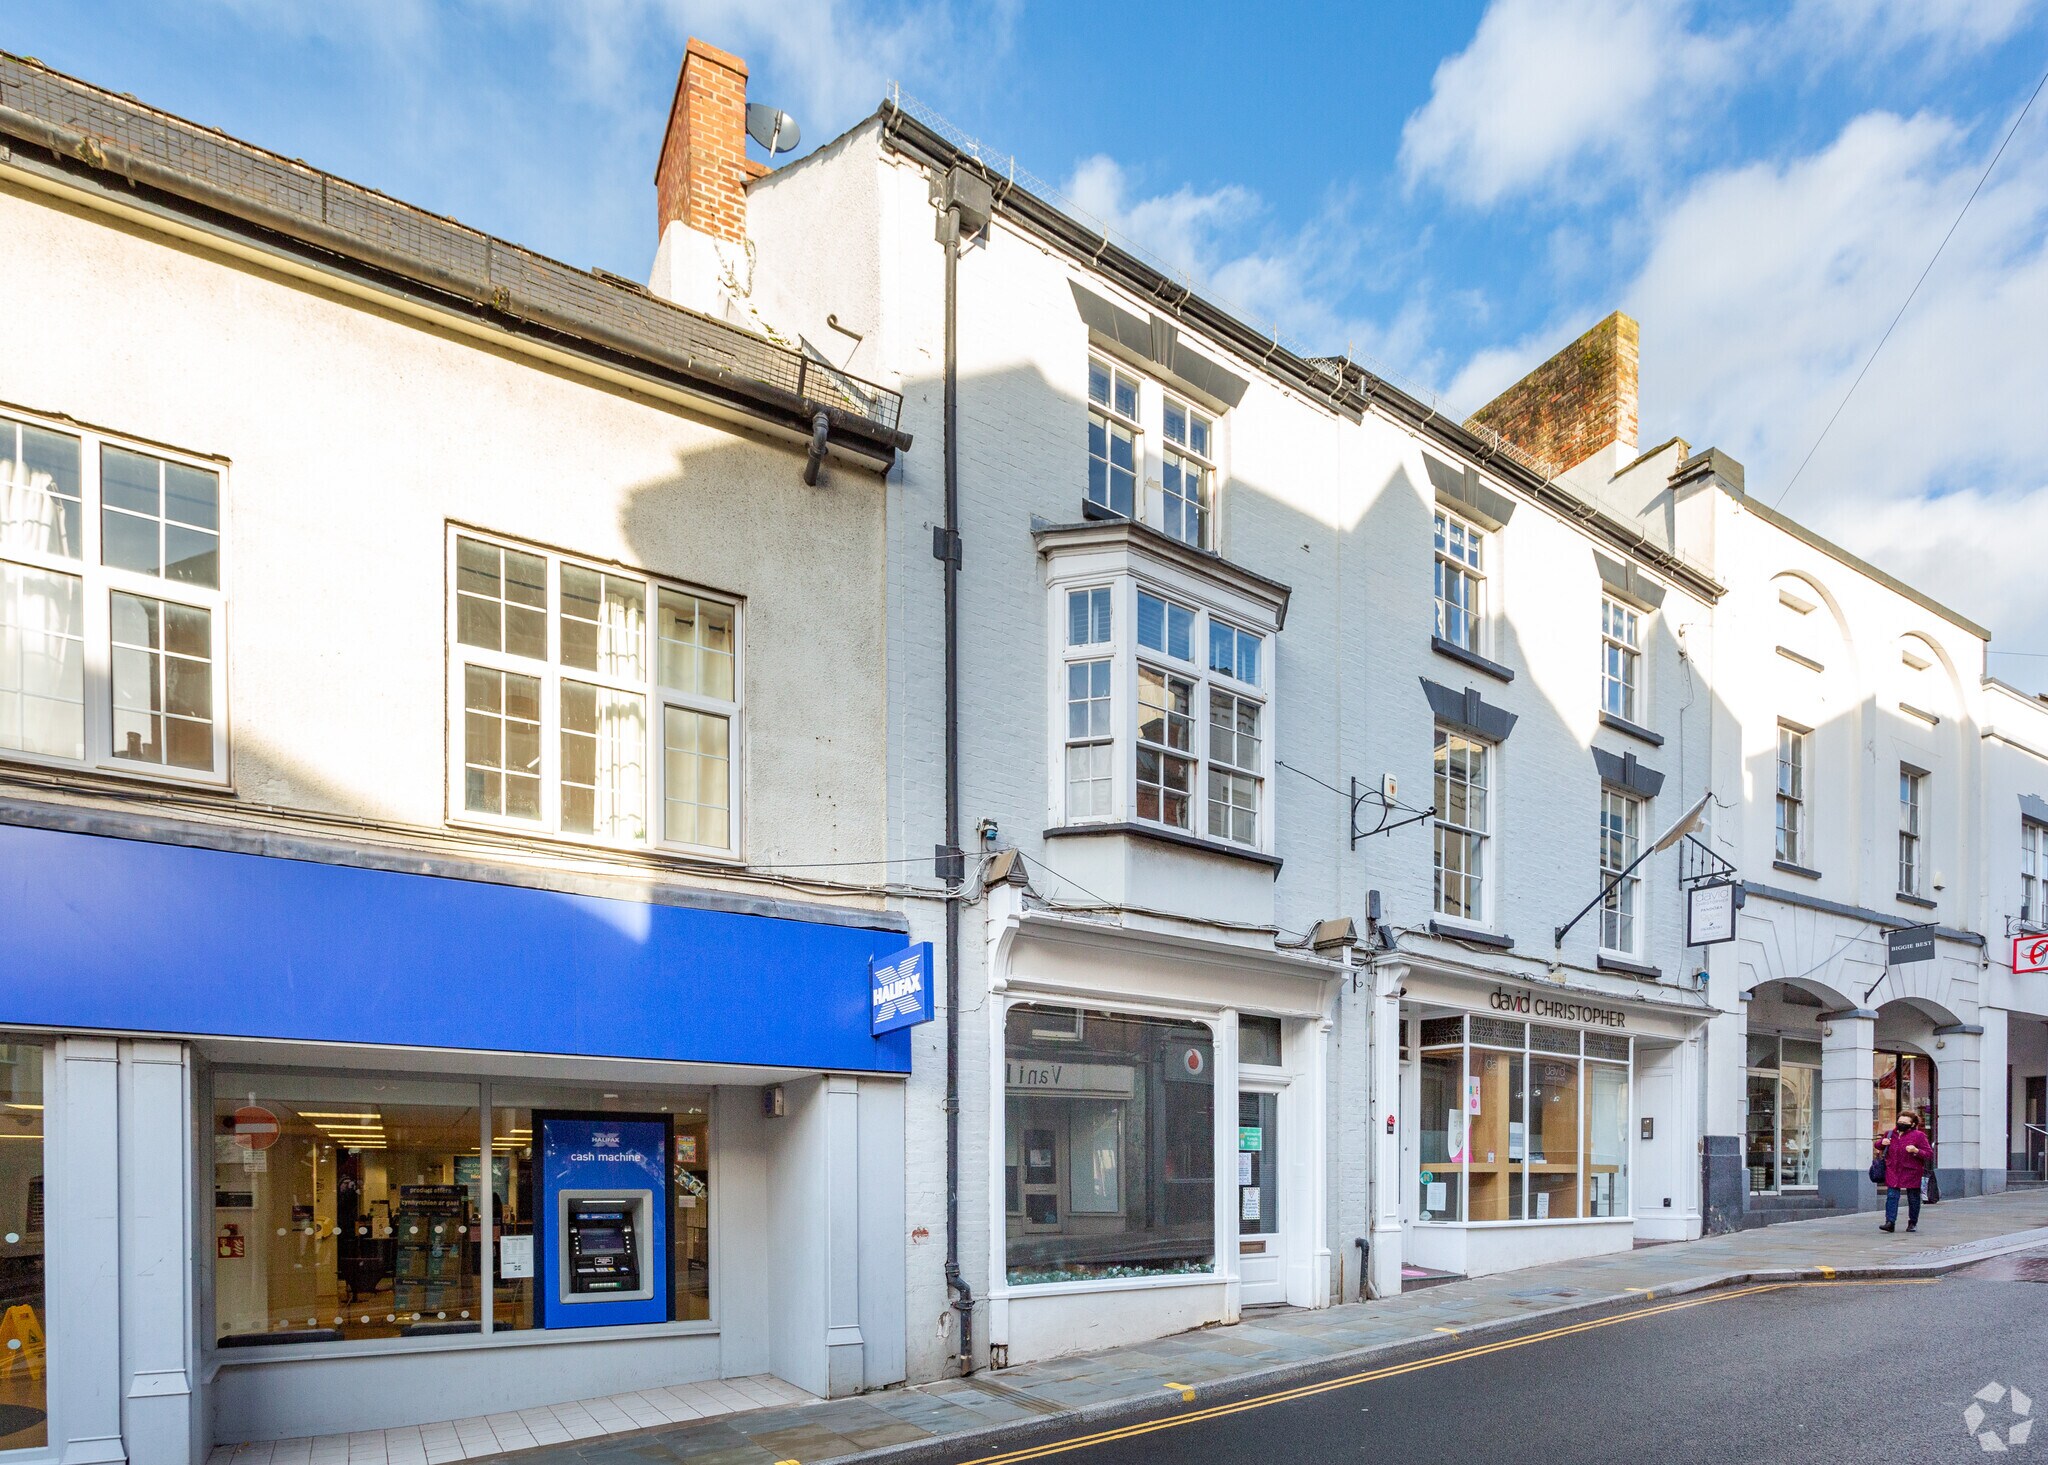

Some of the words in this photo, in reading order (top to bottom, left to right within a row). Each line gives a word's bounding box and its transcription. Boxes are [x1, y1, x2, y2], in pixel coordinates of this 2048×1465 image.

[1696, 887, 1729, 902] david
[1891, 943, 1914, 951] BIGGIE
[1915, 940, 1932, 948] BEST
[873, 972, 922, 1007] HALIFAX
[1490, 986, 1531, 1014] david
[1535, 998, 1626, 1028] CHRISTOPHER
[570, 1151, 595, 1162] cash
[598, 1152, 641, 1162] machine
